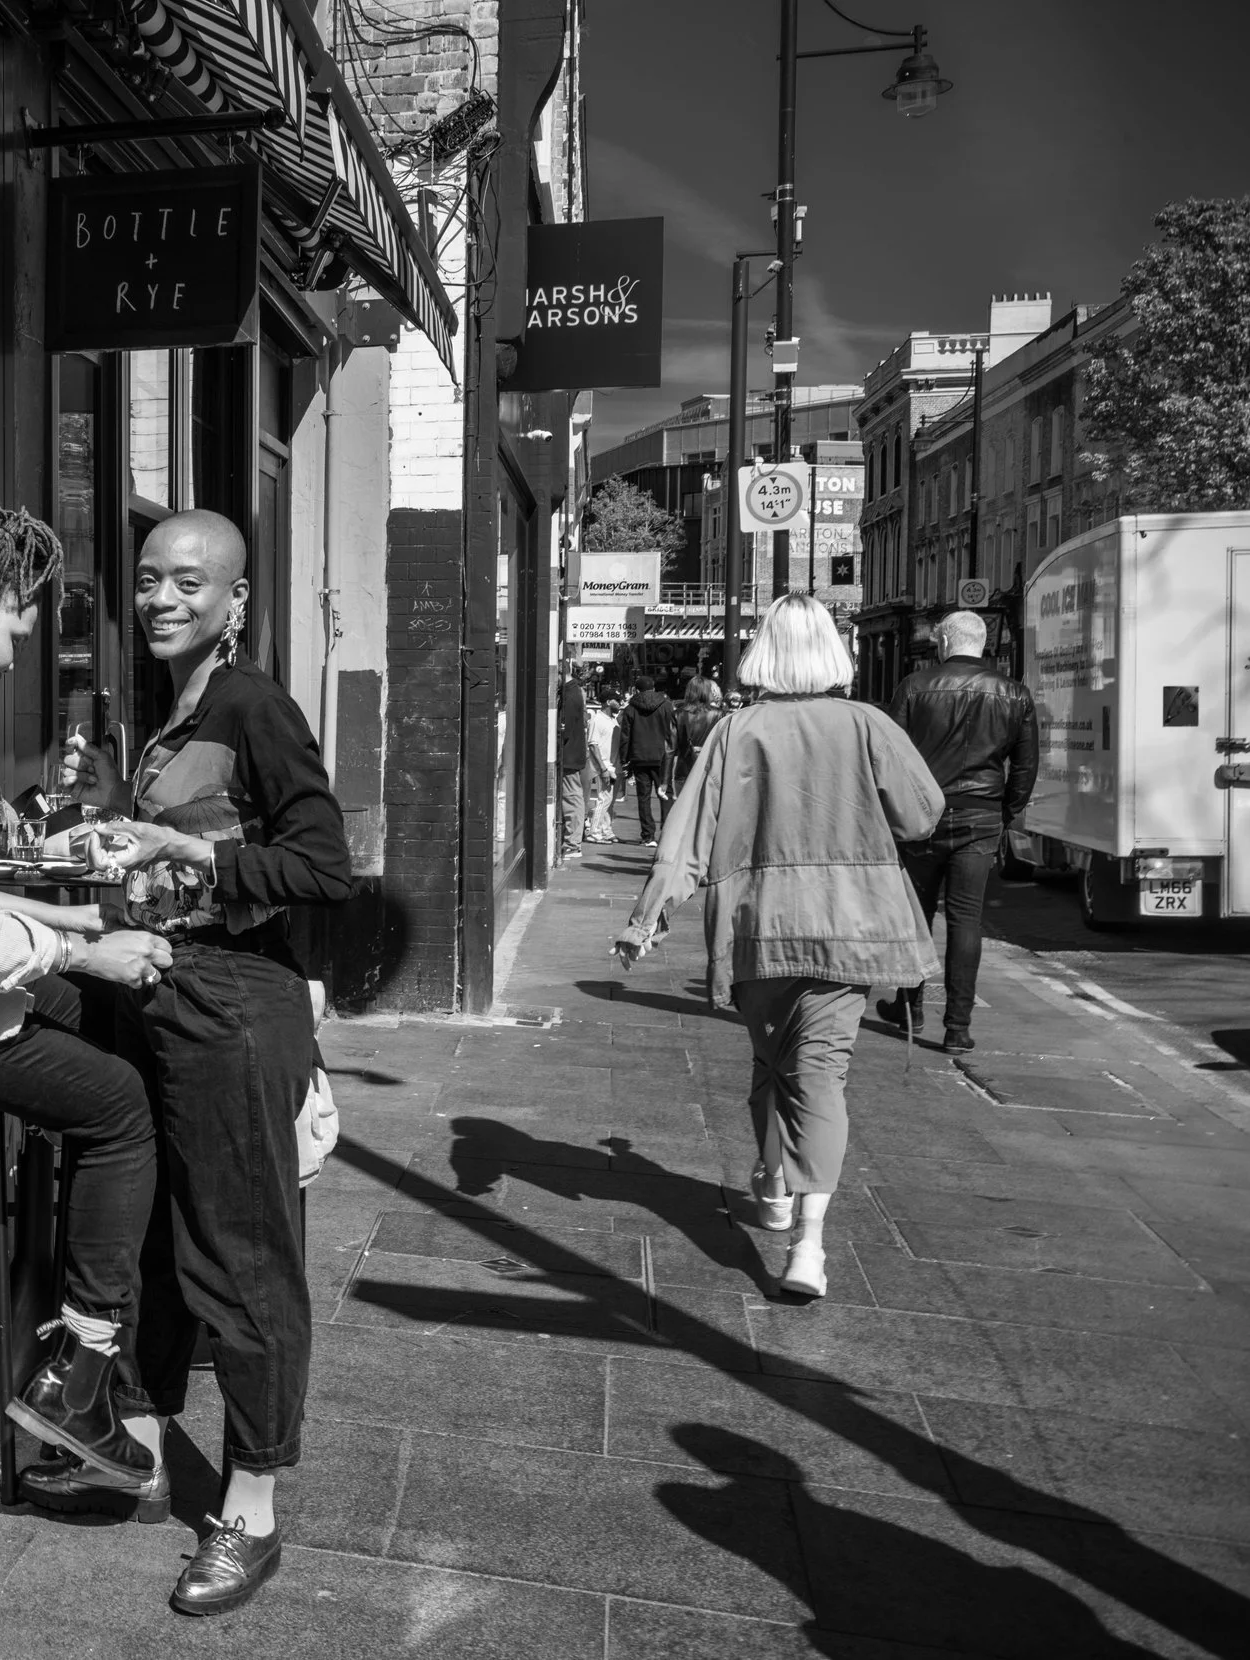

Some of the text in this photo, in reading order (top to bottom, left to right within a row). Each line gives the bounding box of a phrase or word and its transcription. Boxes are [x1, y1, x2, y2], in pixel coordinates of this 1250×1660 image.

[77, 207, 232, 249] BOTTLE
[116, 281, 186, 314] RYE
[527, 304, 639, 328] ARSONS
[758, 485, 791, 496] 4.3m
[815, 477, 856, 492] TON
[582, 581, 650, 592] MoneyGram
[1149, 881, 1192, 894] LM66
[1155, 896, 1187, 910] ZRX
